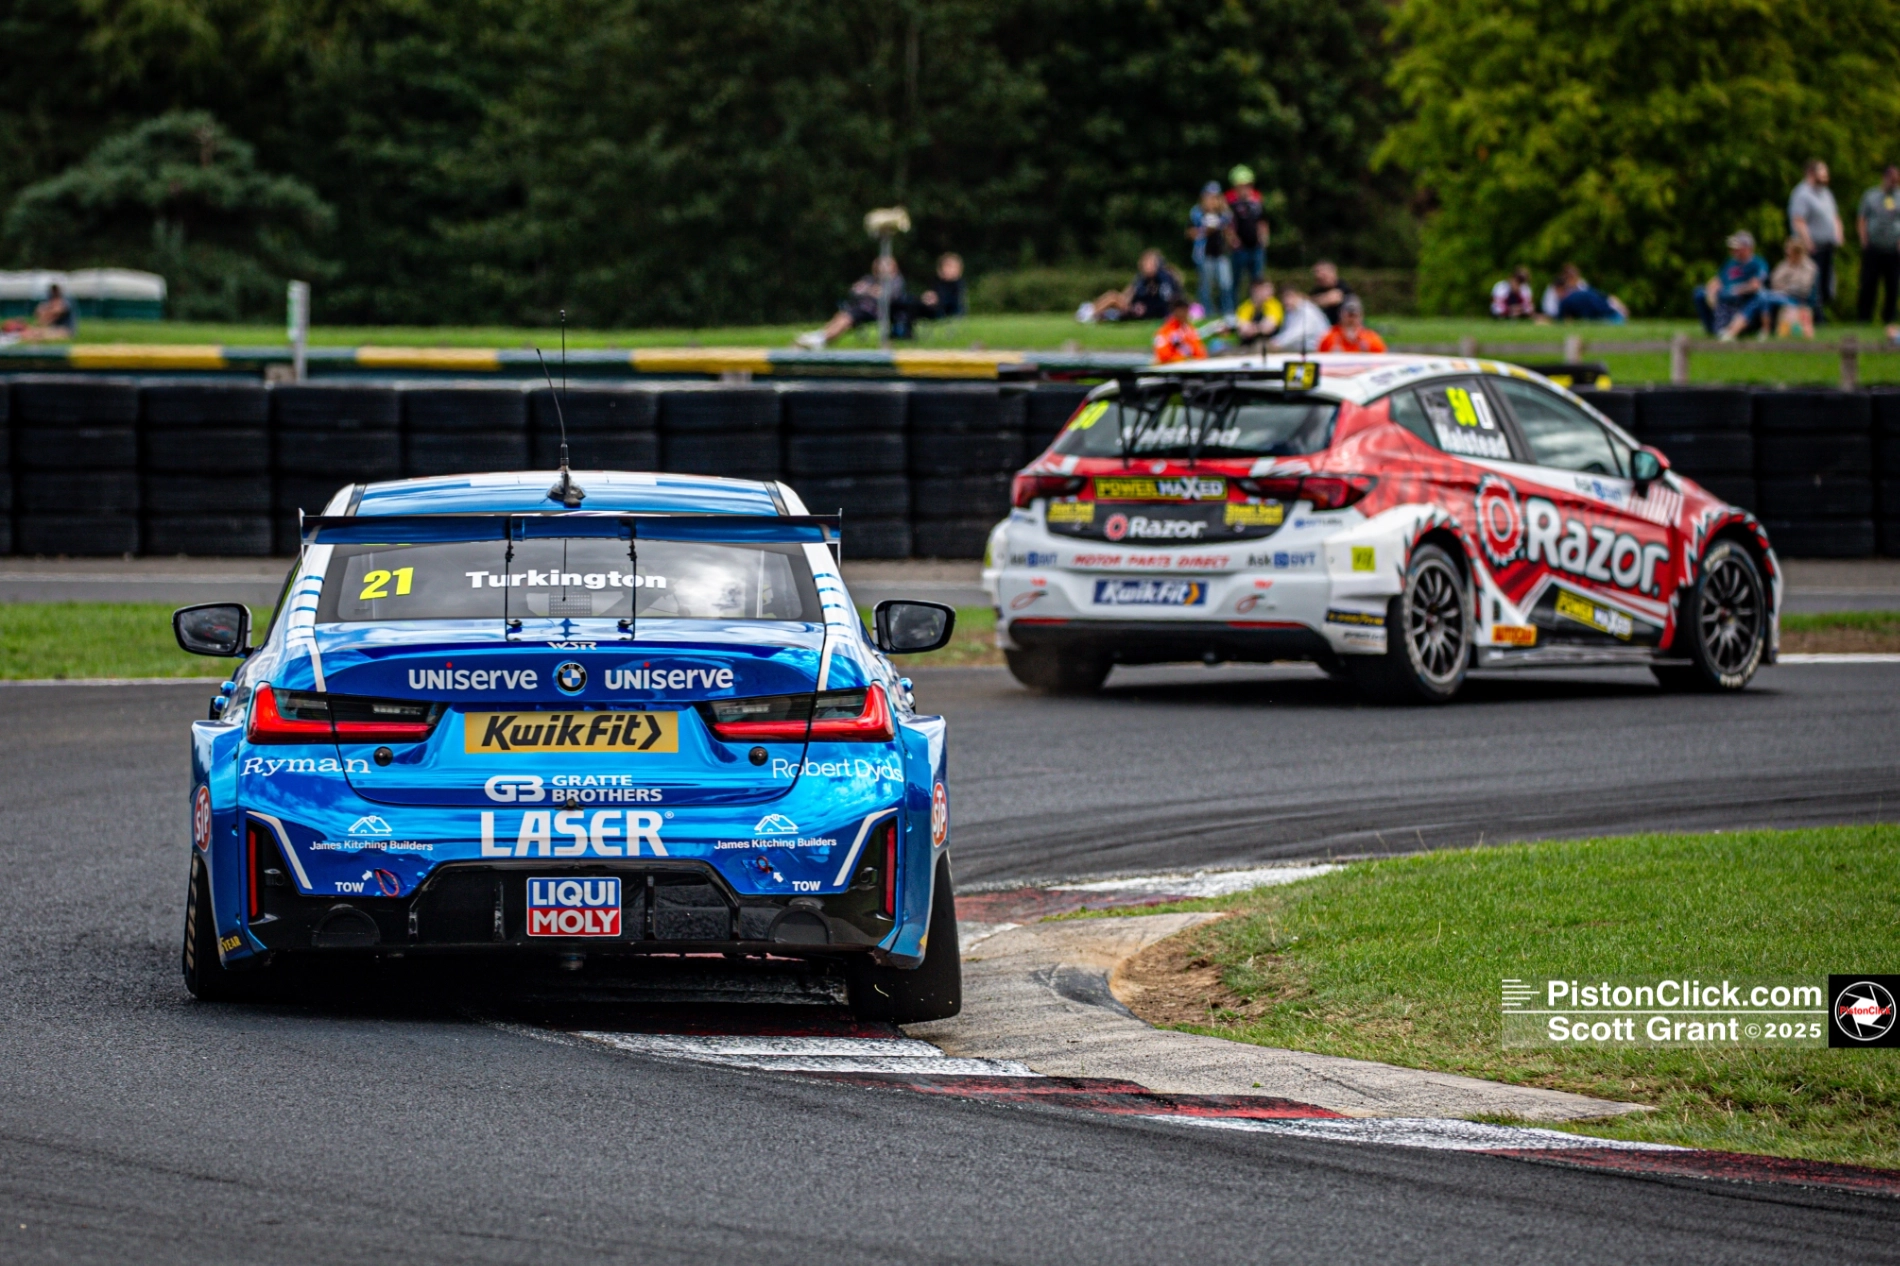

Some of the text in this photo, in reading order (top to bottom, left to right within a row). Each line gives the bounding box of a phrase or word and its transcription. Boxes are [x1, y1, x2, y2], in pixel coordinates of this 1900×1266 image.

[1127, 516, 1208, 538] Razor
[1073, 554, 1122, 567] MOTOR
[1177, 555, 1230, 568] DIRECT
[360, 566, 414, 600] 21
[466, 569, 667, 590] Turkington
[547, 641, 597, 651] WSR
[240, 757, 372, 777] Ryman
[772, 756, 853, 779] Robert
[551, 775, 634, 787] GRATTE
[552, 788, 663, 802] BROTHERS
[195, 793, 209, 844] STP
[933, 790, 948, 838] STP
[309, 839, 434, 852] James Kitching Builders
[714, 837, 838, 850] James Kitching Builders
[335, 881, 365, 893] TOW
[532, 880, 616, 908] LIQUI
[792, 881, 822, 892] TOW
[532, 909, 619, 934] MOLY
